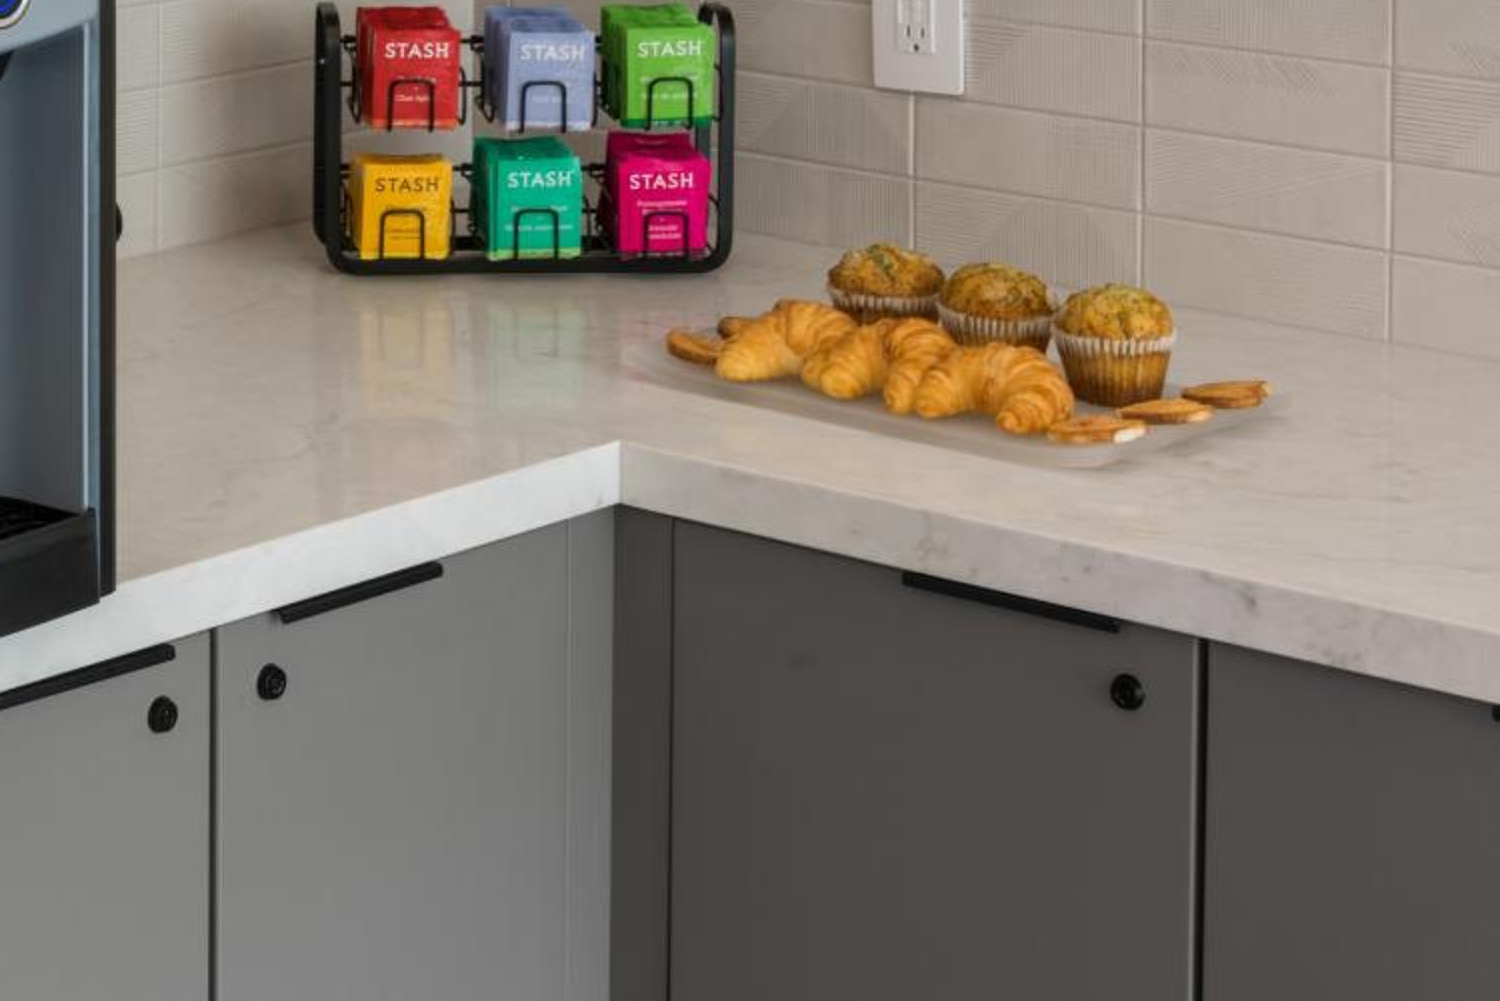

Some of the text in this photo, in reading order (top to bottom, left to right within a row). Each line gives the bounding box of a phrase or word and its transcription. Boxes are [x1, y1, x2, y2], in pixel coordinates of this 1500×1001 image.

[384, 42, 450, 58] STASH
[520, 44, 585, 60] STASH
[637, 39, 701, 57] STASH
[374, 177, 439, 193] STASH
[507, 170, 572, 189] STASH
[628, 172, 694, 190] STASH
